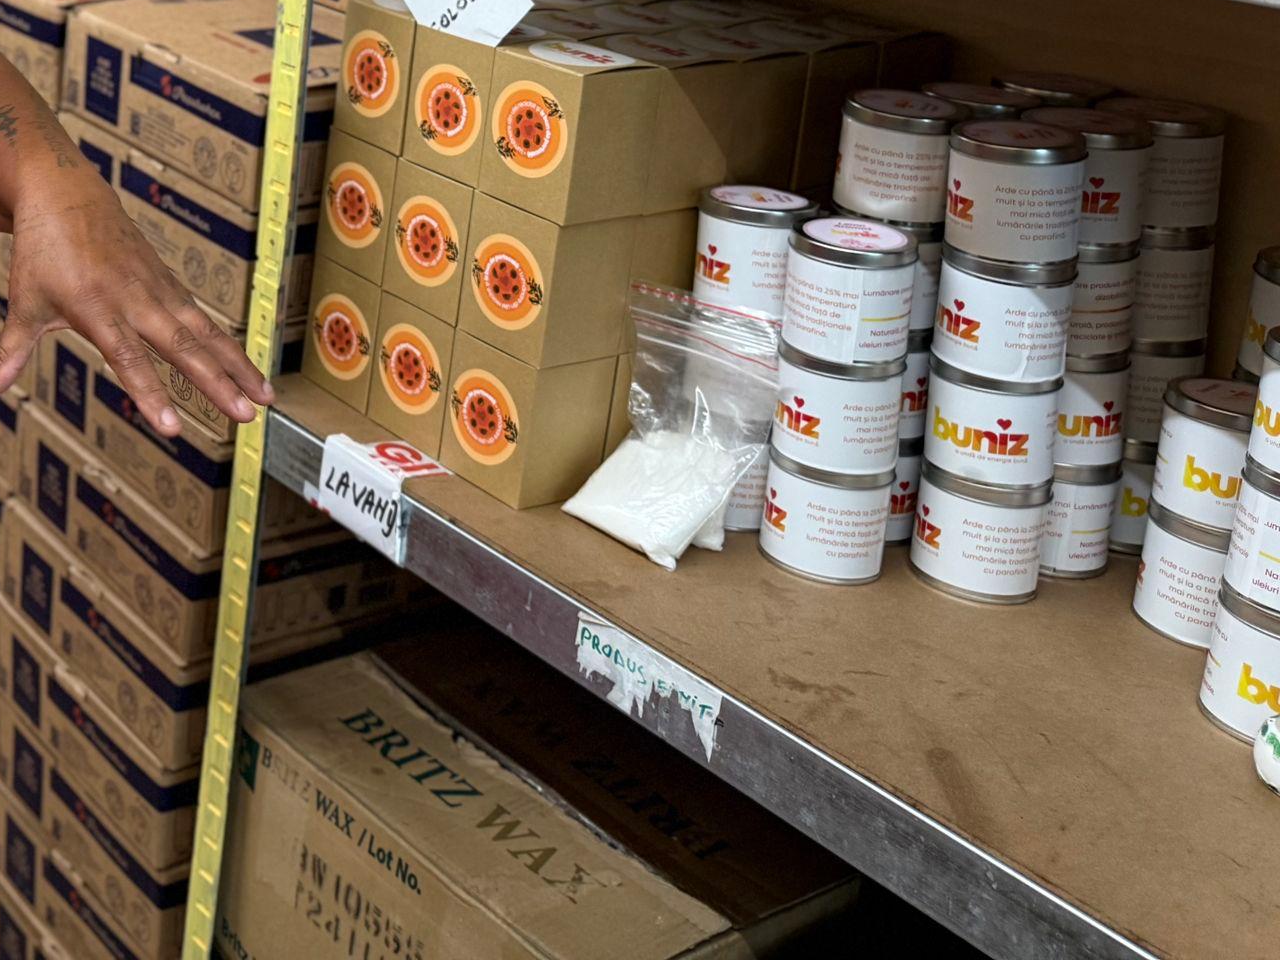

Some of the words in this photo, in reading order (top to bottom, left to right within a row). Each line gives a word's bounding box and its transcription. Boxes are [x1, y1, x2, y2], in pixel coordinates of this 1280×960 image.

[933, 405, 1029, 456] buniz
[1057, 401, 1121, 437] uniz
[1159, 568, 1176, 580] mult
[1186, 579, 1194, 588] la
[1160, 556, 1177, 569] Arde
[1179, 566, 1189, 575] cu
[1169, 585, 1184, 596] mai
[1175, 611, 1185, 620] cu
[1187, 616, 1213, 628] paraf
[580, 626, 647, 685] PRODUS
[337, 706, 486, 809] BRITZ
[474, 803, 618, 903] WAX
[314, 788, 356, 839] WAX
[368, 835, 393, 871] Lot
[395, 857, 422, 895] No.
